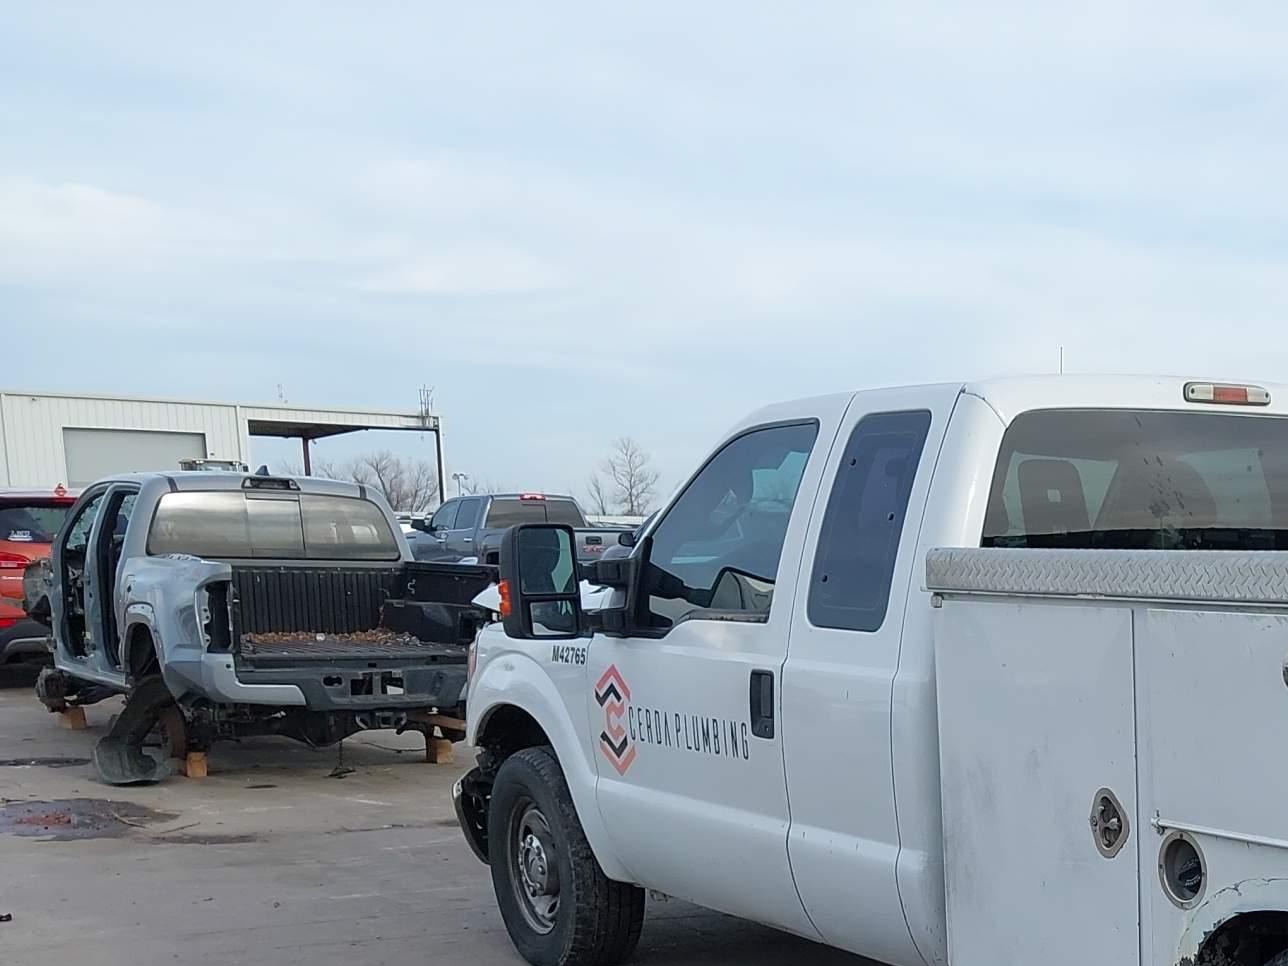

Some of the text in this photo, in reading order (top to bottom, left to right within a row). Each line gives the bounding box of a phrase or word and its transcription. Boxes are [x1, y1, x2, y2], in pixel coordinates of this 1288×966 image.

[551, 645, 586, 665] M42765
[628, 706, 750, 760] CERDA PLUMBING
